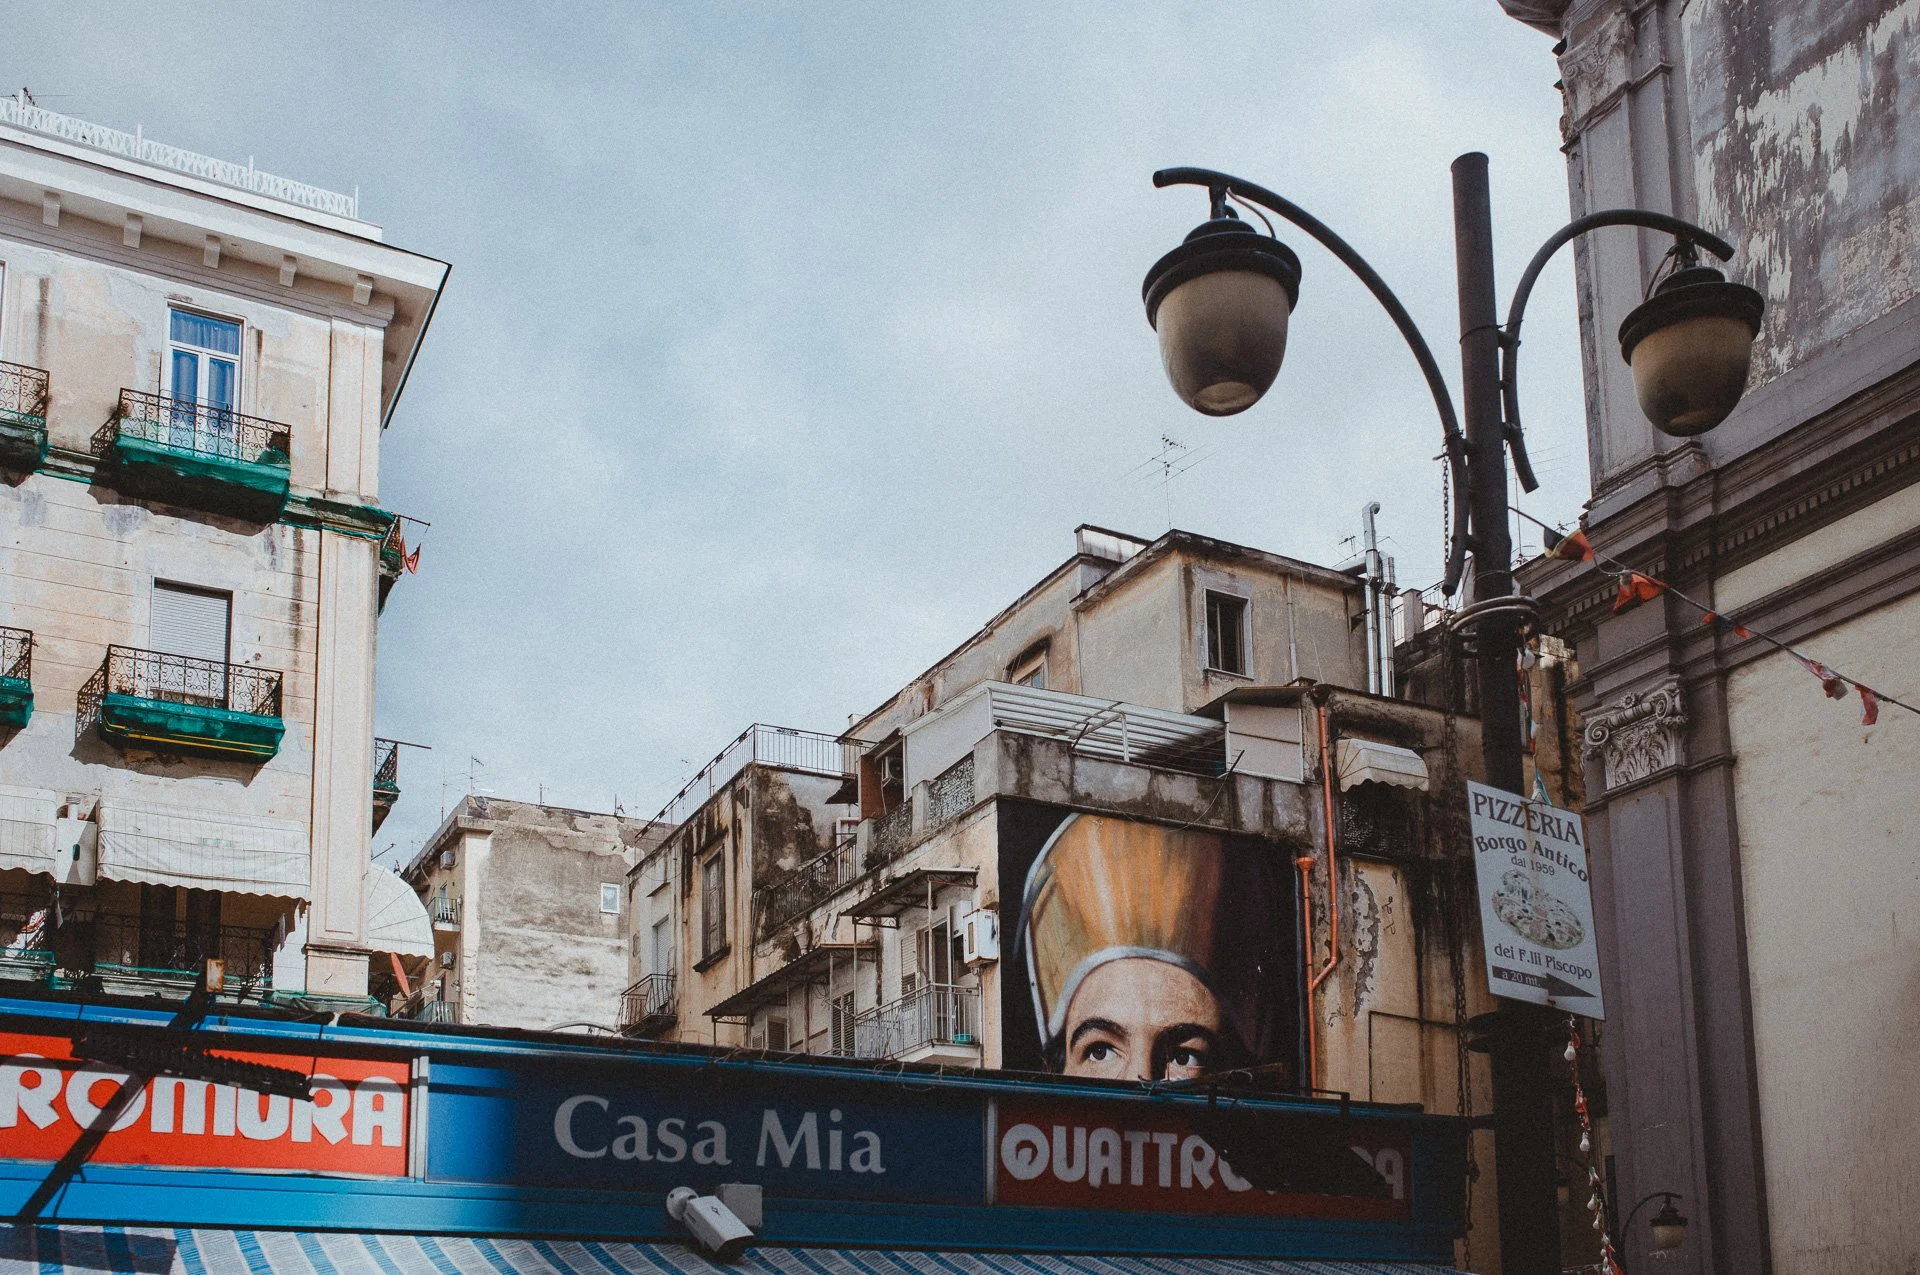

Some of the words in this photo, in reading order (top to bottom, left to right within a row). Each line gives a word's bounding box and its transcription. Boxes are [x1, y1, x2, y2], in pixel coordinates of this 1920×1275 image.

[1472, 791, 1581, 846] PIZZERIA
[1475, 836, 1527, 854] Borgo
[1533, 840, 1588, 882] Antico
[1511, 856, 1527, 868] dal
[1530, 859, 1555, 876] 1959
[1494, 943, 1516, 960] dei
[1519, 948, 1542, 966] F.lli
[1545, 954, 1593, 980] Piscopo
[1502, 972, 1509, 980] a
[1511, 972, 1523, 982] 20
[1526, 976, 1540, 987] mt.
[553, 1094, 732, 1165] Casa
[756, 1108, 886, 1174] Mia
